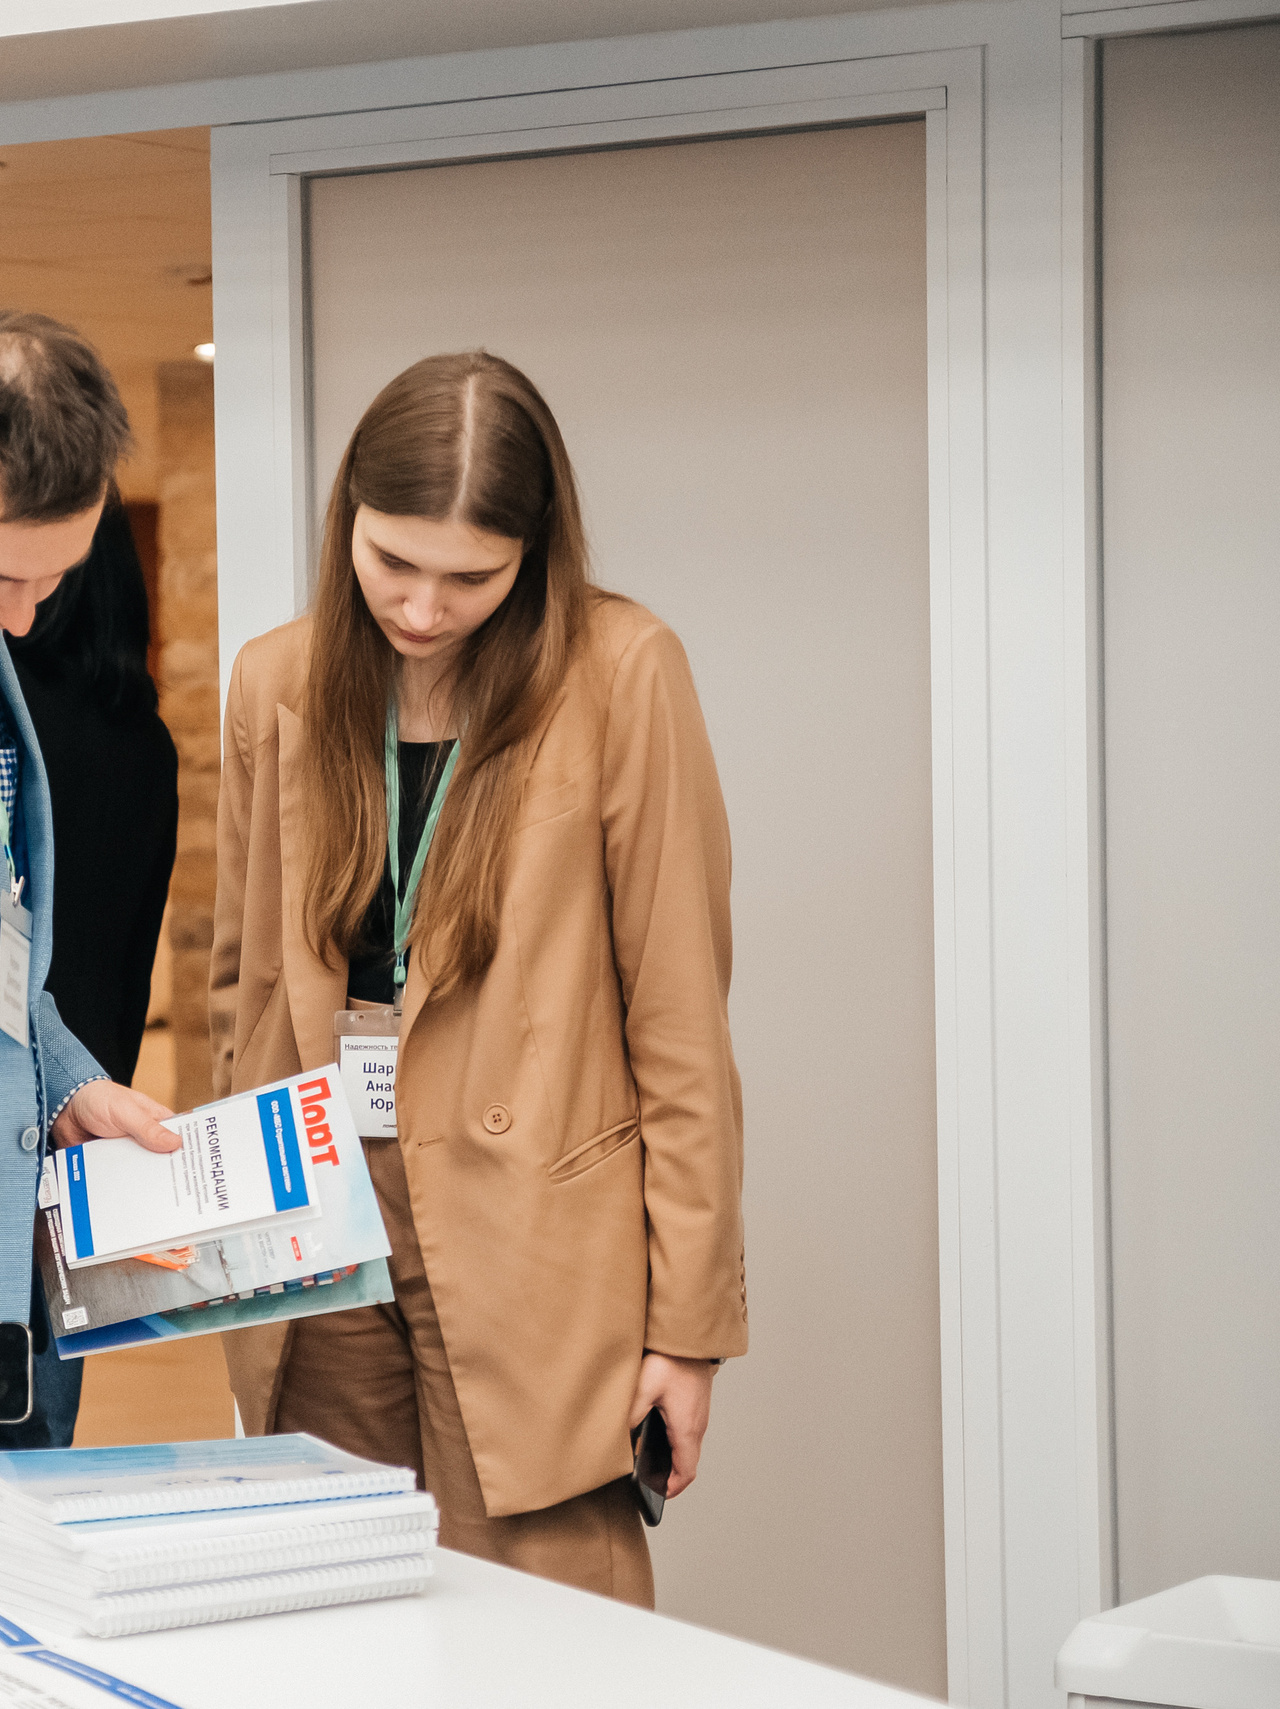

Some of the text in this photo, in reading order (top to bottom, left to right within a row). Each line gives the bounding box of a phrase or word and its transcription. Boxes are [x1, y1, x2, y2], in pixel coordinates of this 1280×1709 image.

[344, 1043, 388, 1051] Надежность
[363, 1062, 394, 1077] Шар
[366, 1080, 396, 1092] Ана
[271, 1100, 279, 1113] ООО
[370, 1098, 394, 1113] Юр
[205, 1116, 229, 1211] РЕКОМЕНДАЦИИ
